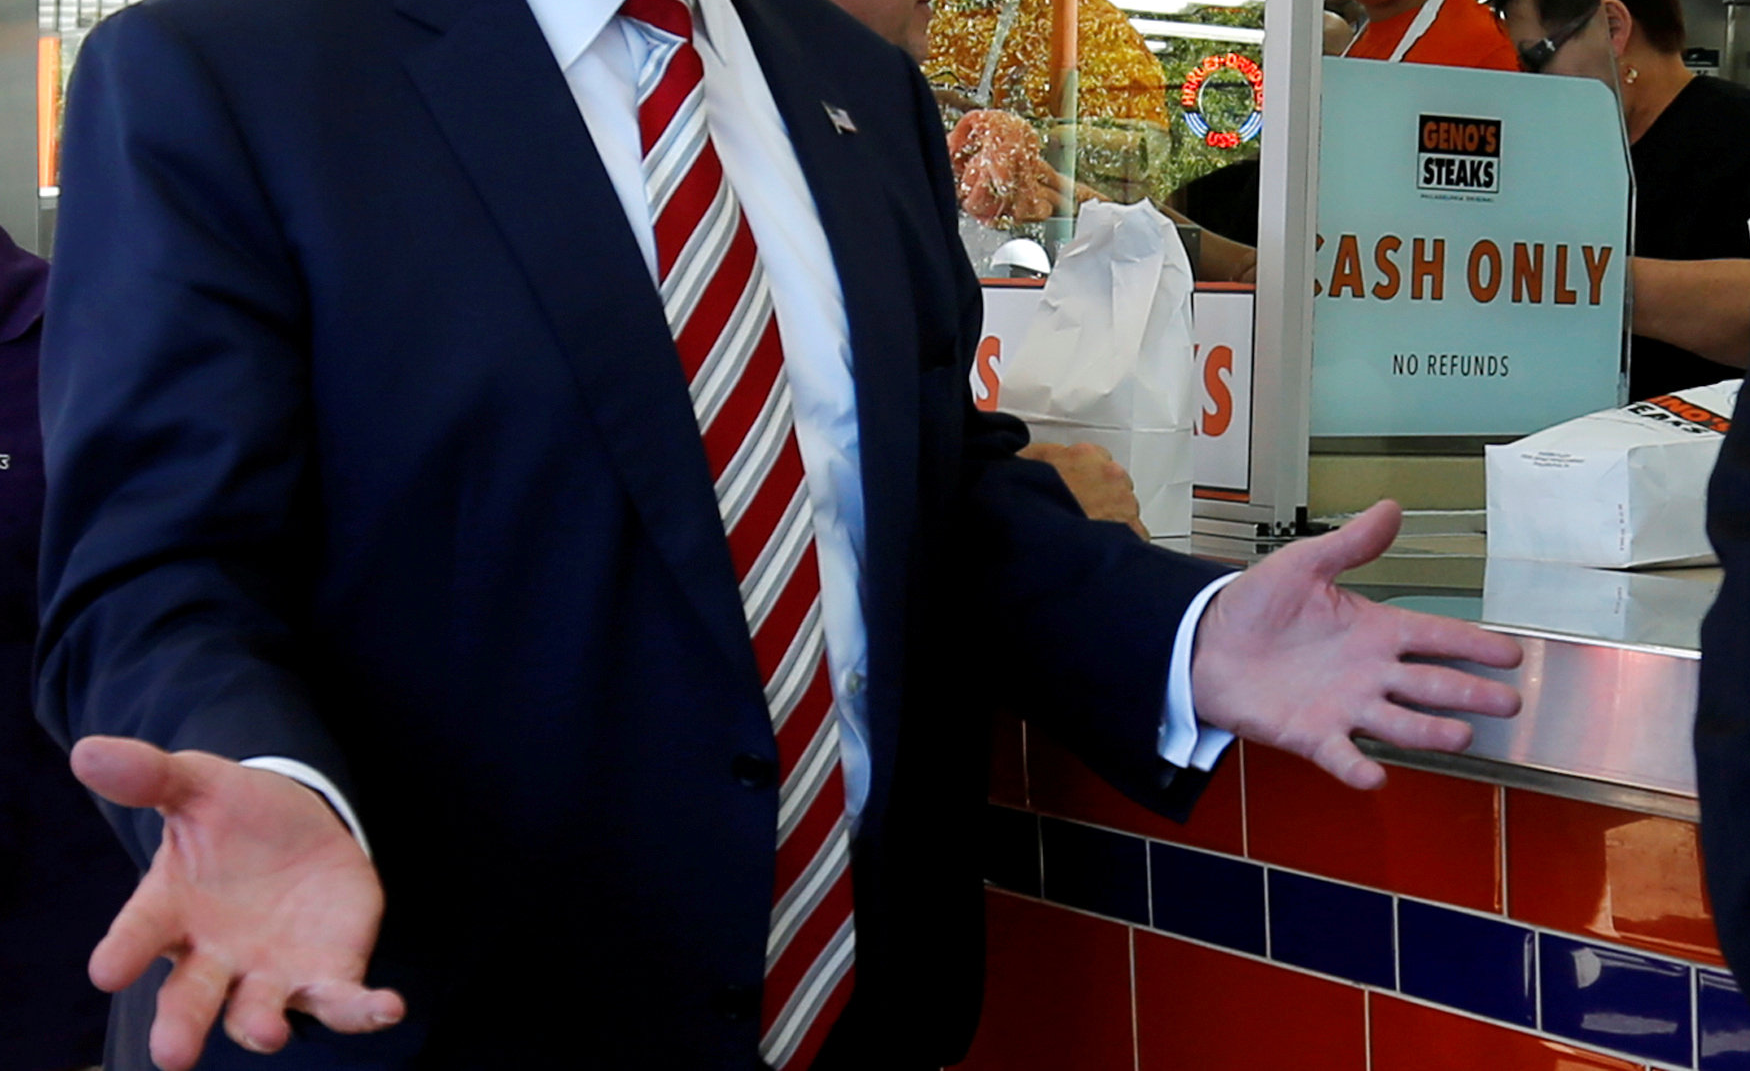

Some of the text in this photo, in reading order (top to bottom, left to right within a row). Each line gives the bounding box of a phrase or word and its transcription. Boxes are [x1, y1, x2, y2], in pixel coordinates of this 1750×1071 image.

[1423, 121, 1497, 153] GENO'S
[1423, 156, 1494, 189] STEAKS
[1467, 239, 1613, 306] ONLY
[1392, 354, 1509, 377] NO REFUNDS
